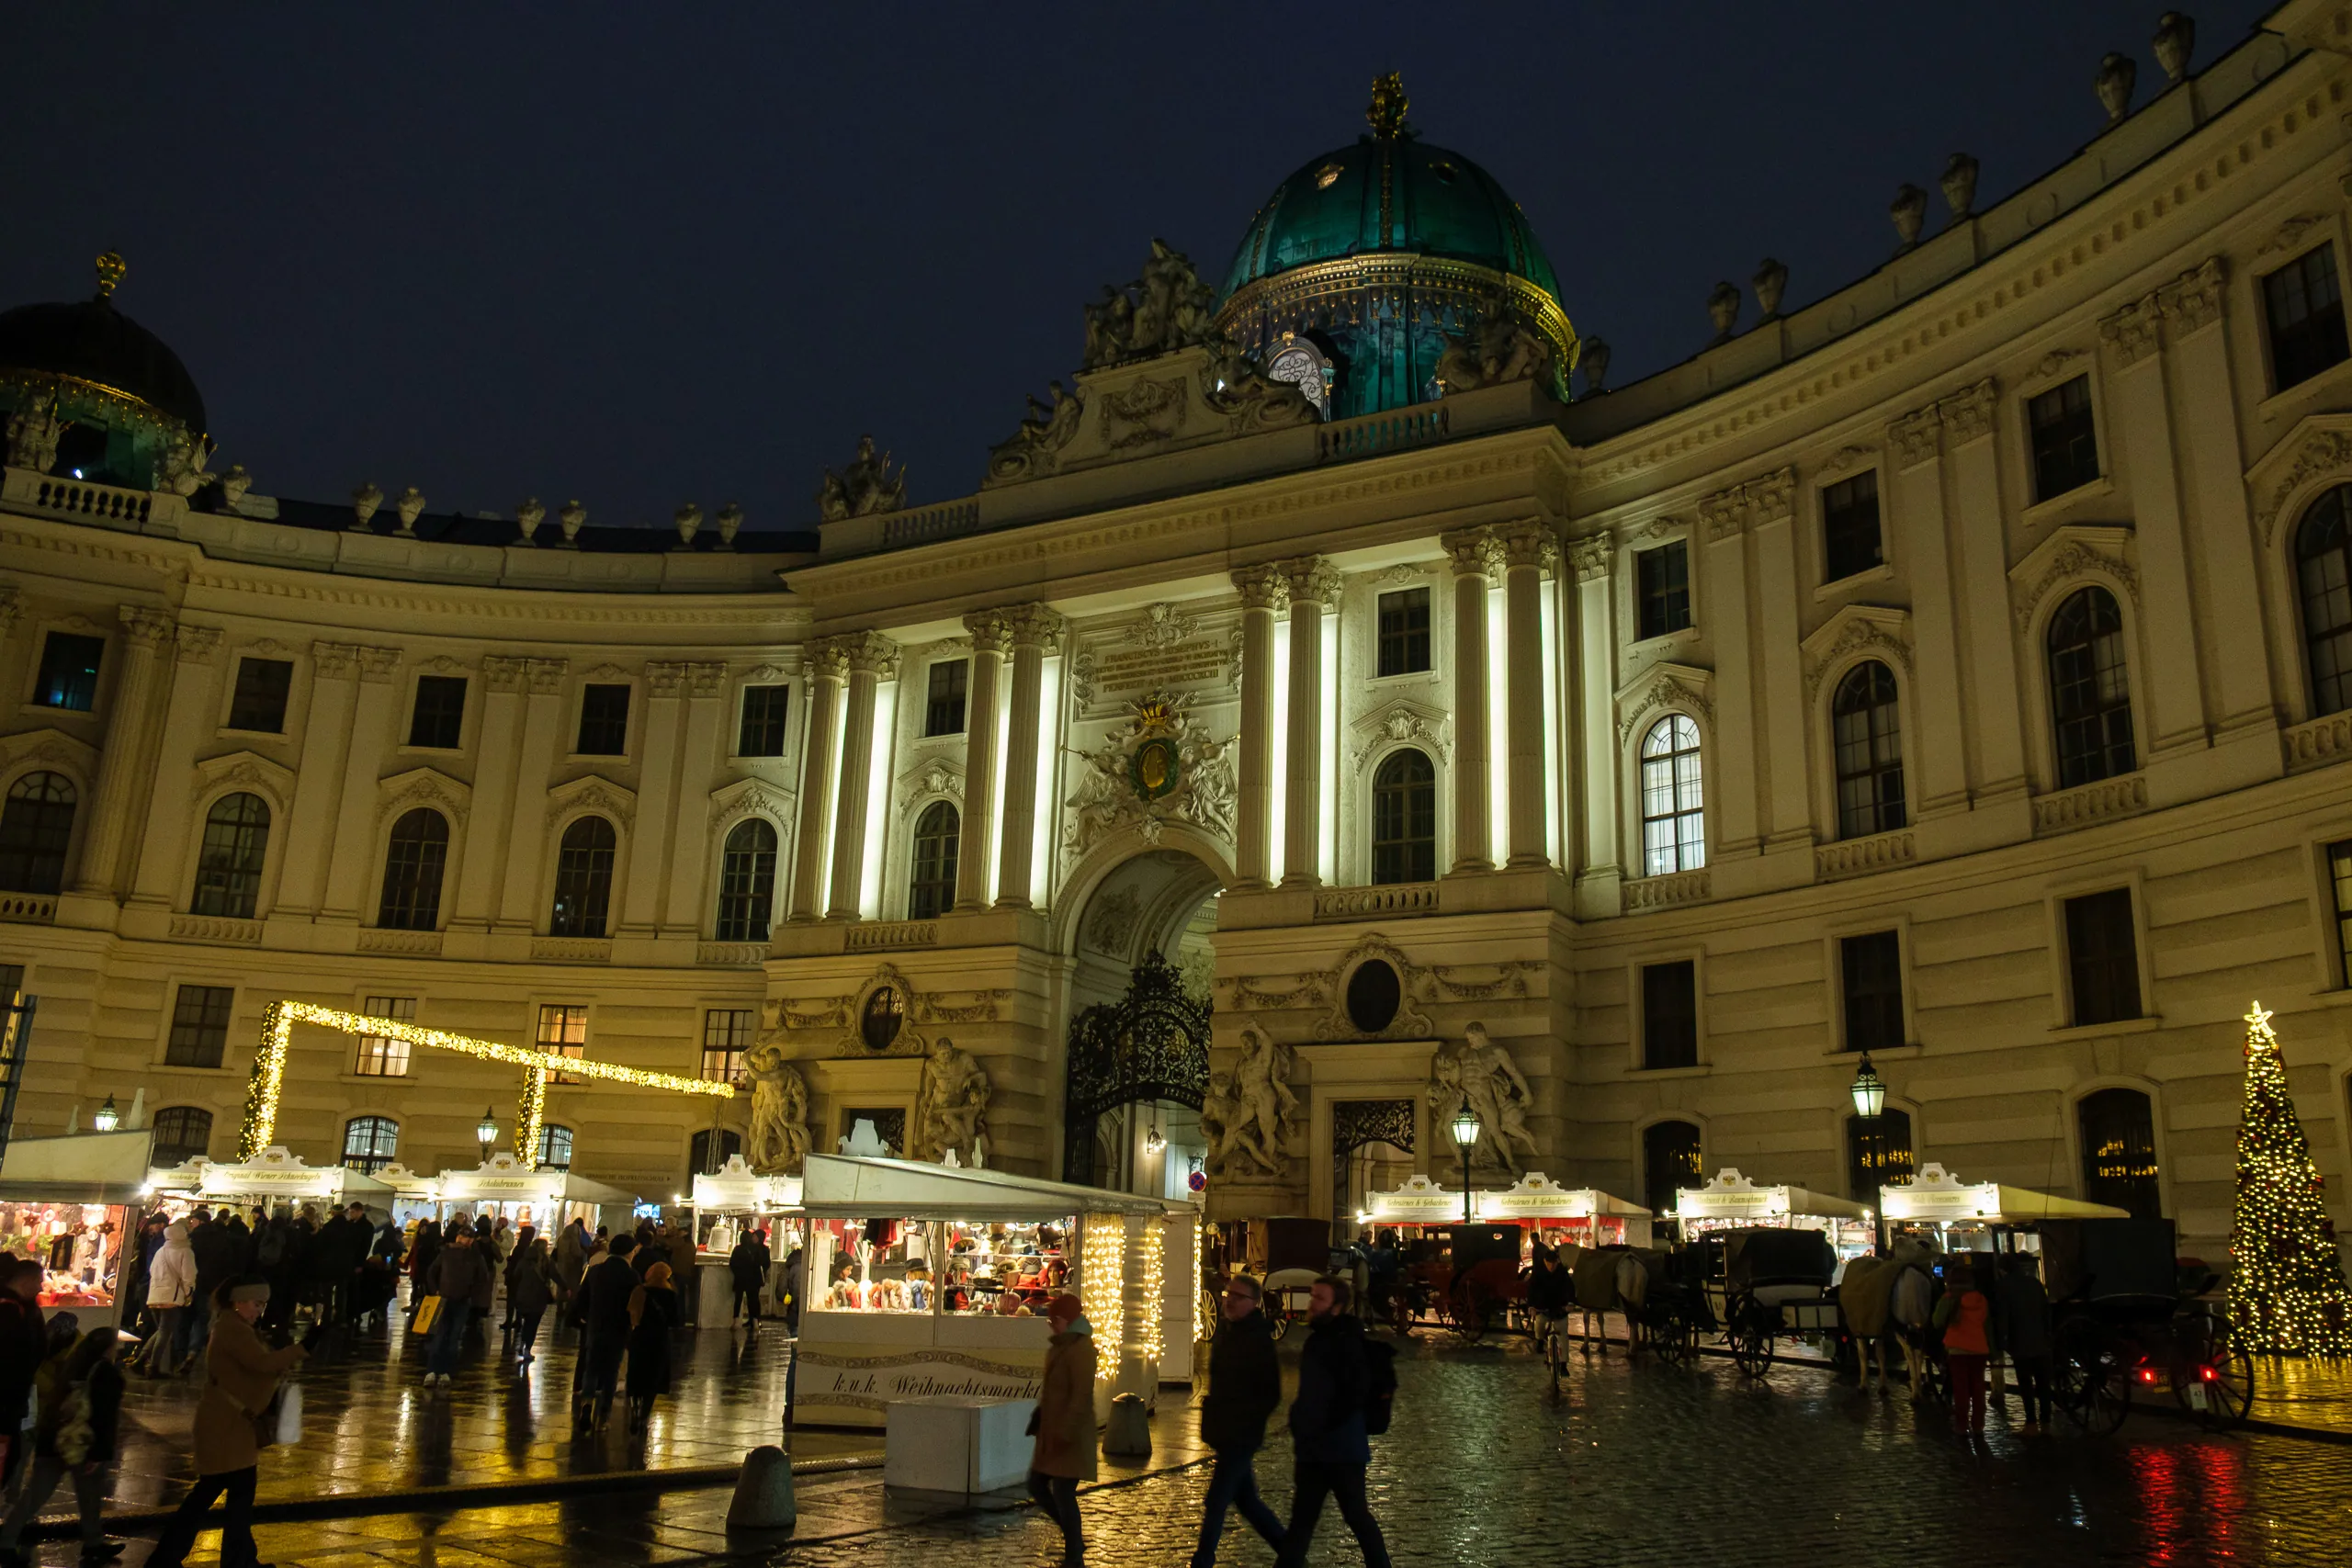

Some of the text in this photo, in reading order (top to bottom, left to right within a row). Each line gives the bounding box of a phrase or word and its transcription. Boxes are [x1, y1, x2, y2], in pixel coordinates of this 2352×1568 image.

[254, 1171, 277, 1180] Wiener
[832, 1373, 1044, 1399] k.u.k. Weihnachtsmarkt
